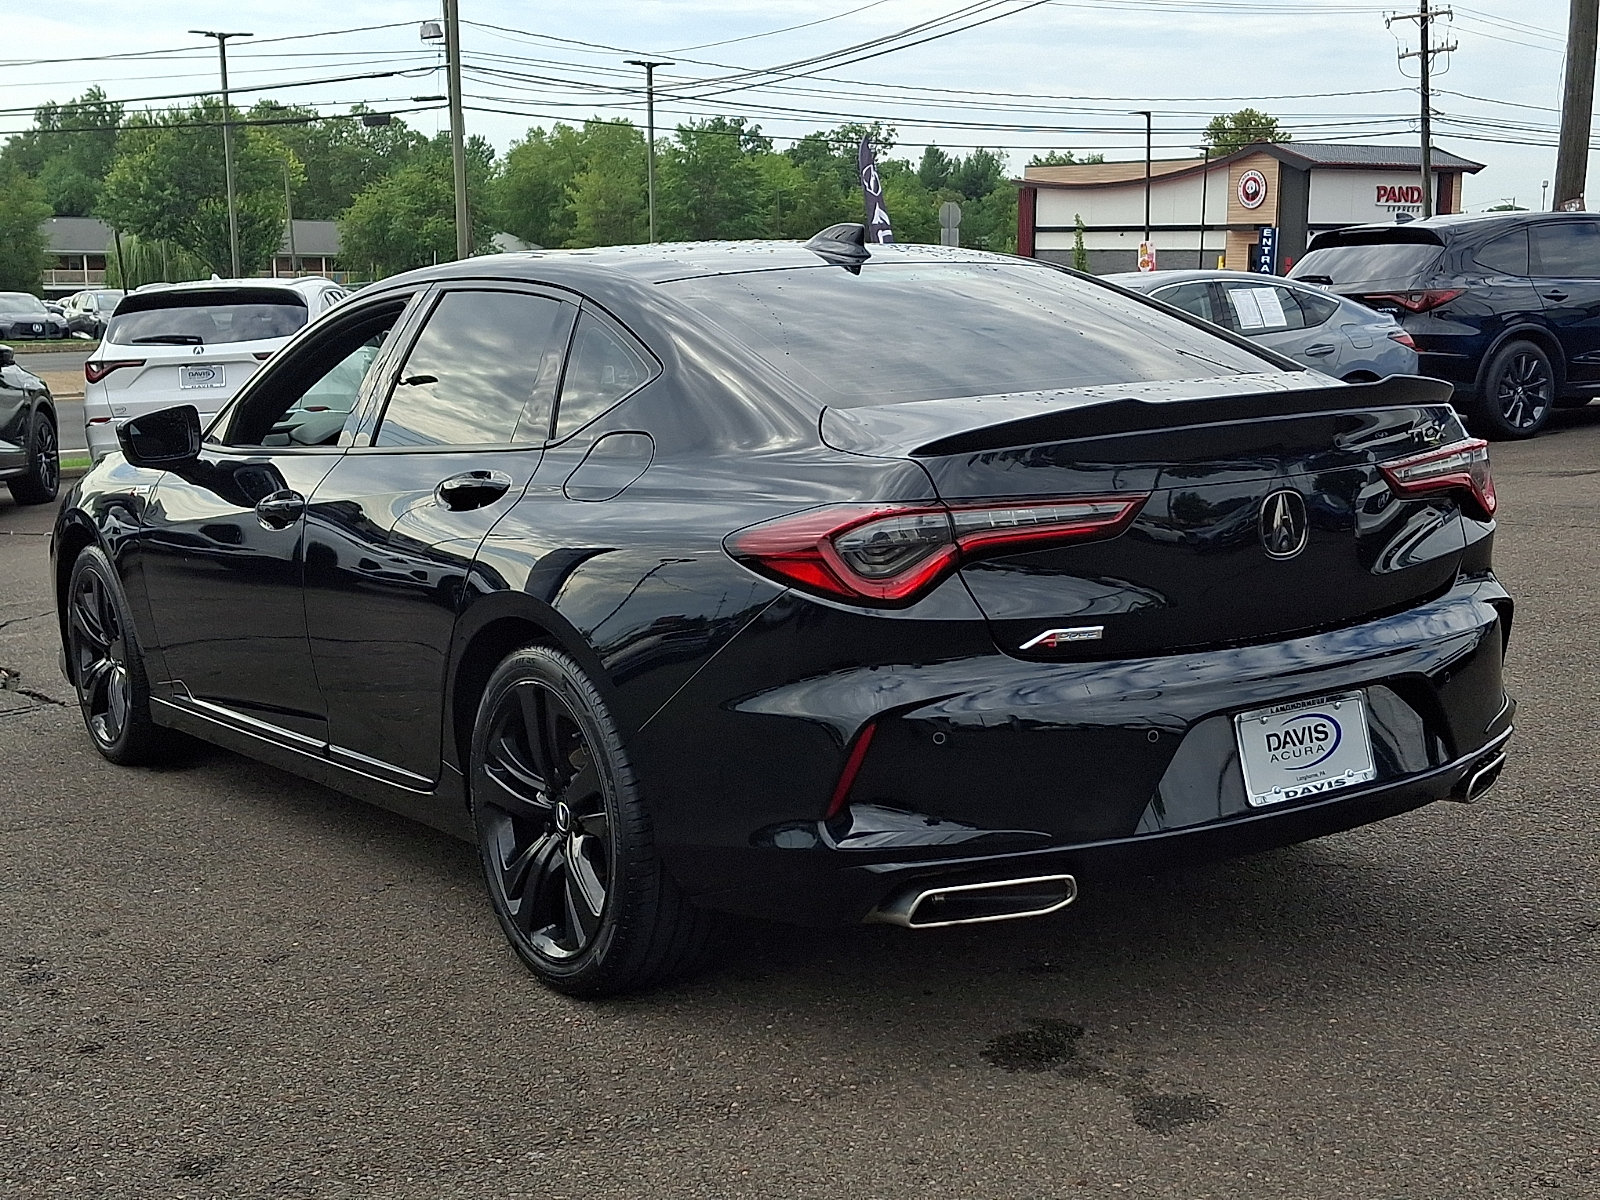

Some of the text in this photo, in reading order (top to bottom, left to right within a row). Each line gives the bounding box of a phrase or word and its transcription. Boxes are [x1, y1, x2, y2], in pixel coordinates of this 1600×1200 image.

[1376, 186, 1422, 204] PAND
[1260, 228, 1272, 275] ENTRA
[1265, 723, 1329, 753] DAVIS
[1270, 744, 1326, 763] ACURA
[1284, 778, 1347, 799] DAVIS
